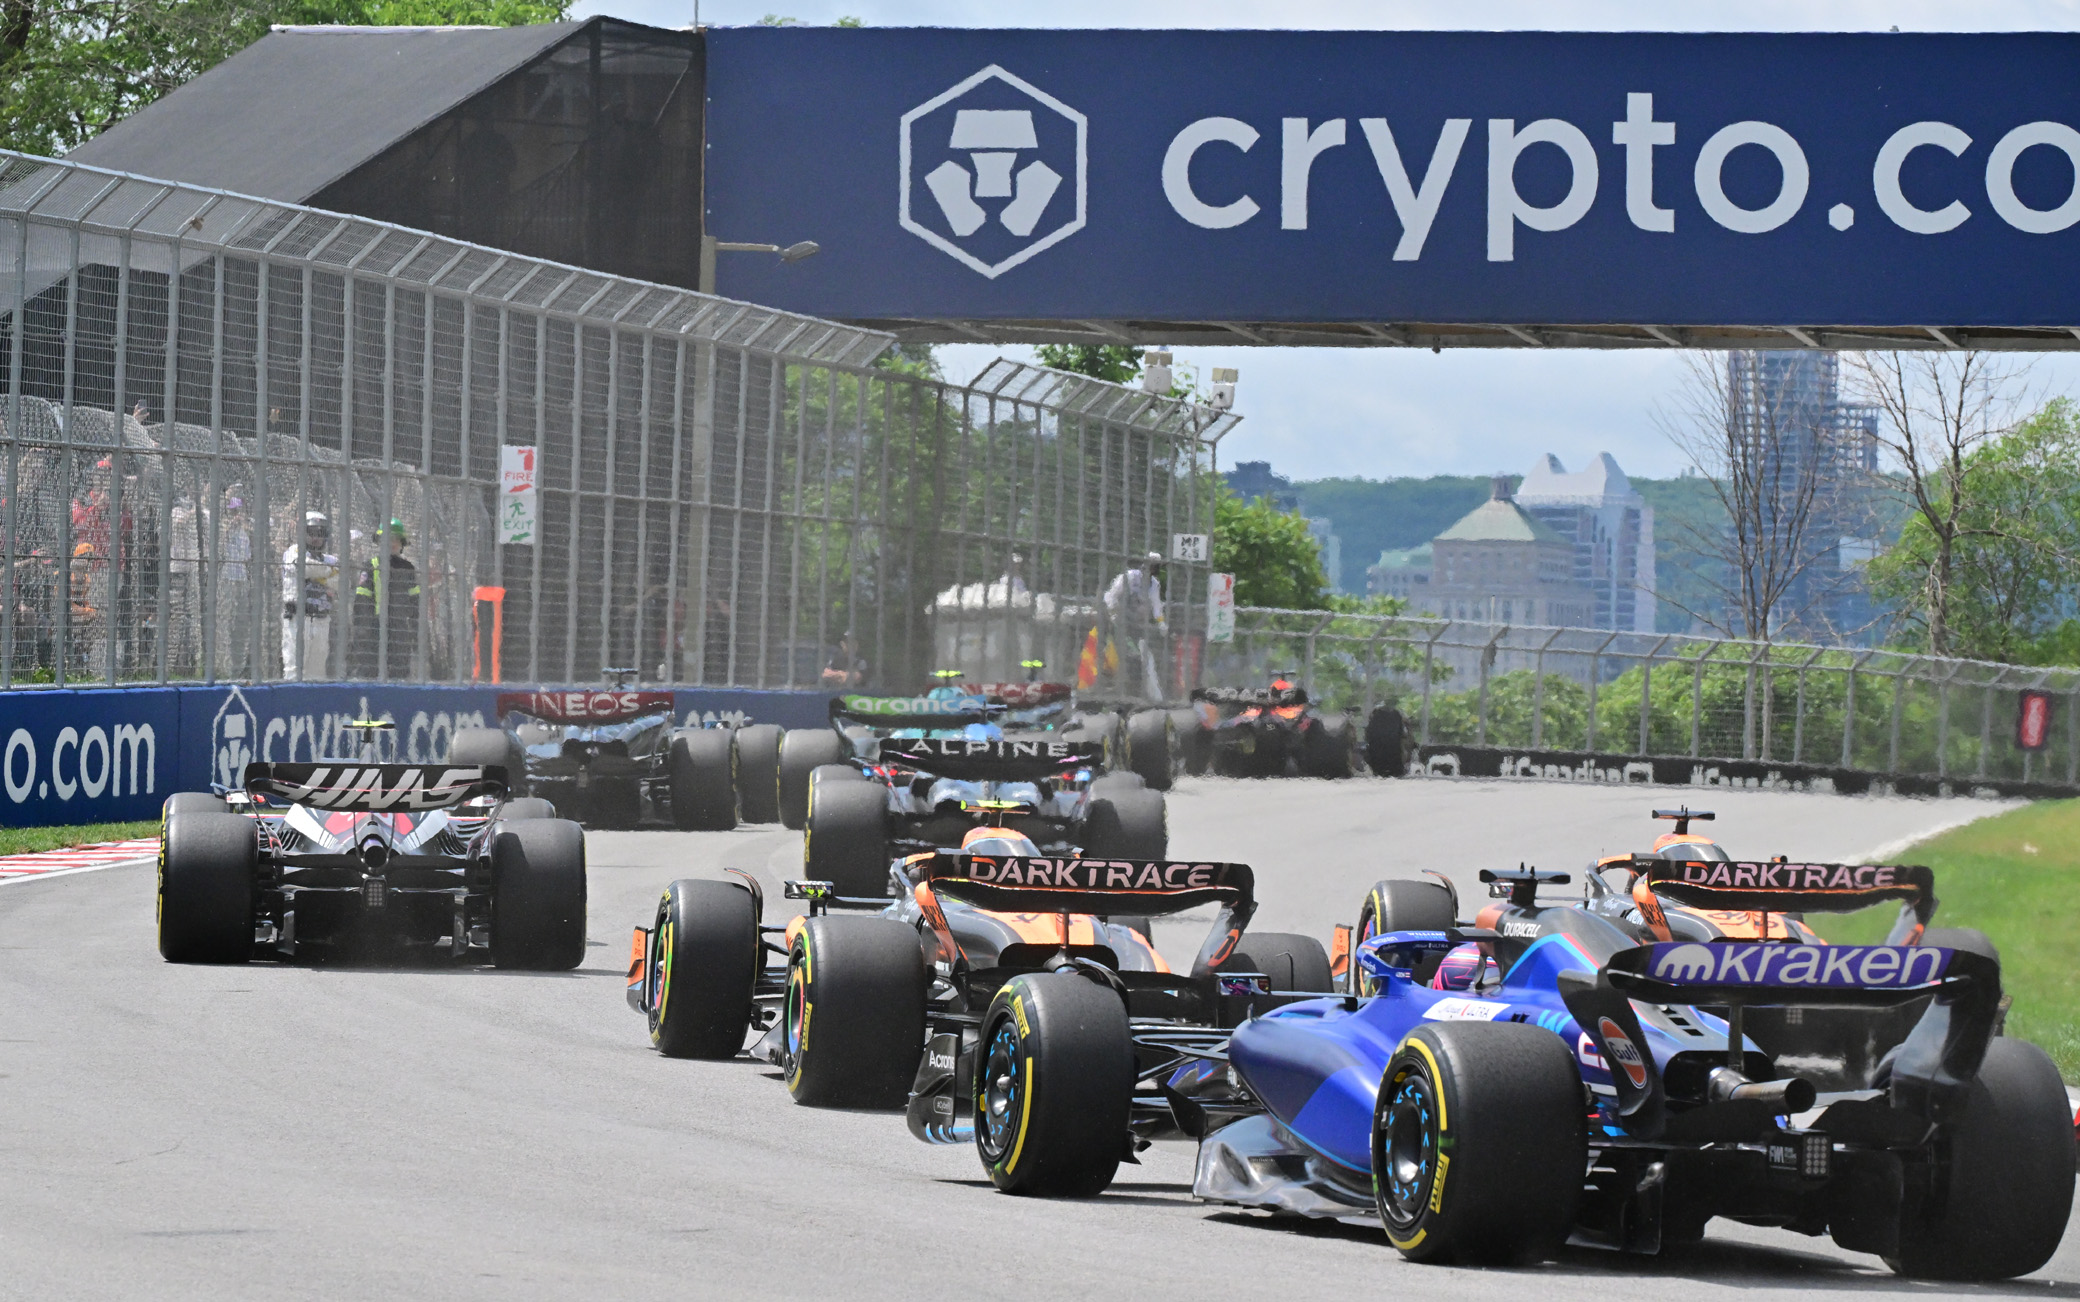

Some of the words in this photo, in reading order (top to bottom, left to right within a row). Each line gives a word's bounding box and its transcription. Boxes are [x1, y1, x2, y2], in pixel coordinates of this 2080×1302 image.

[1161, 92, 2080, 263] crypto.co
[504, 471, 534, 482] FIRE
[503, 520, 534, 530] EXIT
[531, 693, 640, 716] INEOS
[908, 739, 1069, 757] ALPINE
[4, 723, 156, 804] o.com
[273, 768, 482, 809] HAAS
[970, 857, 1213, 889] DARKTRACE
[1684, 862, 1896, 889] DARKTRACE
[1503, 922, 1542, 938] DURACELL
[1716, 944, 1942, 985] kraken
[1608, 1041, 1641, 1062] Gulf
